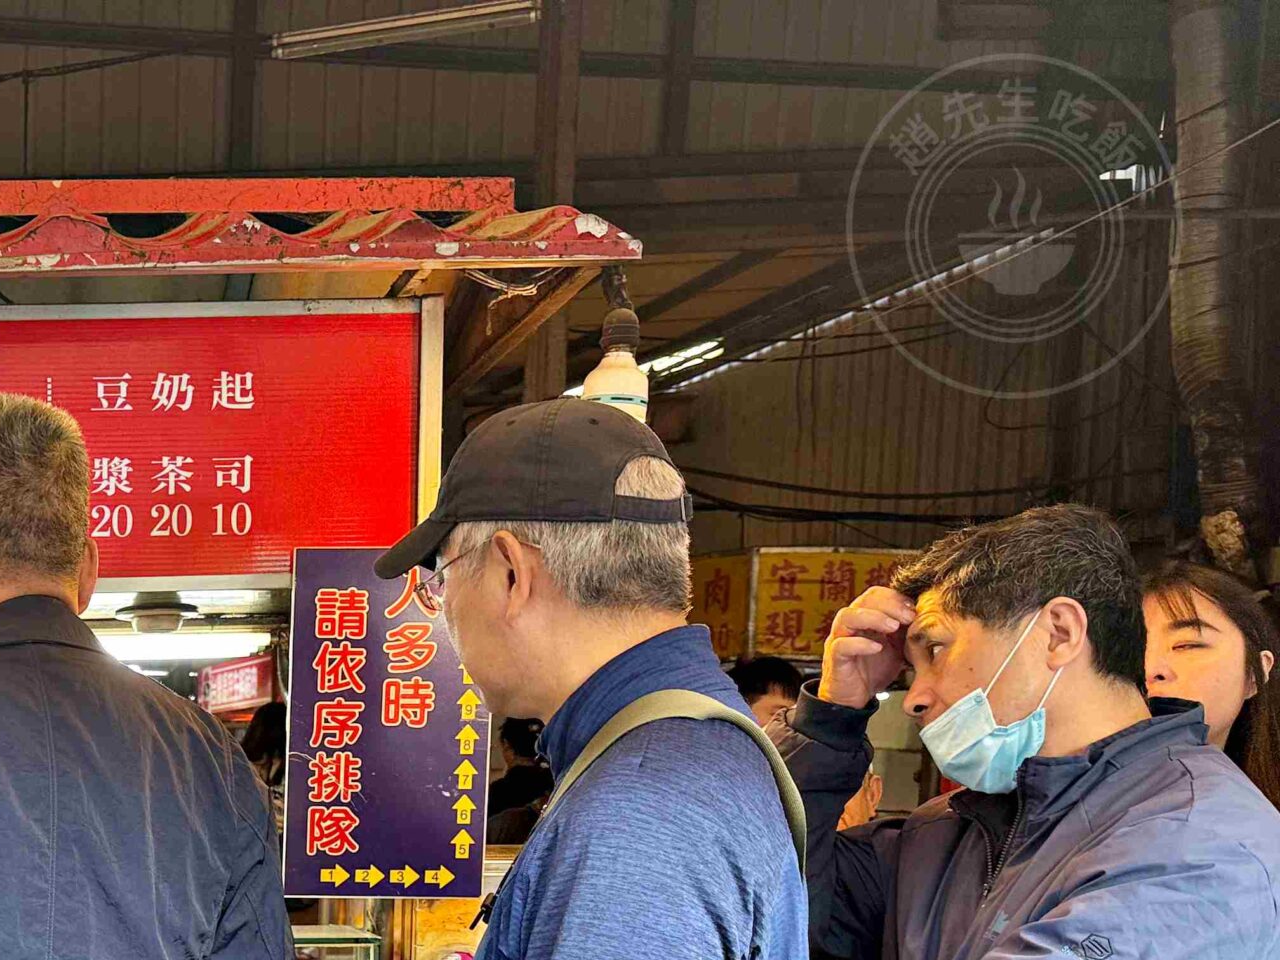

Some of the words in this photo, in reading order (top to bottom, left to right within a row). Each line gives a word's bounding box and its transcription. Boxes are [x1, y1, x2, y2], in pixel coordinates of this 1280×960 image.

[91, 504, 133, 538] 20
[150, 503, 193, 537] 20
[212, 502, 252, 536] 10
[381, 565, 439, 728] 人多時
[465, 704, 473, 716] 9
[307, 587, 369, 856] 請依序排隊
[463, 739, 471, 751] 8
[462, 774, 469, 785] 7
[460, 809, 468, 821] 6
[458, 843, 466, 855] 5
[361, 869, 370, 882] 2
[396, 869, 405, 882] 3
[431, 870, 440, 882] 4
